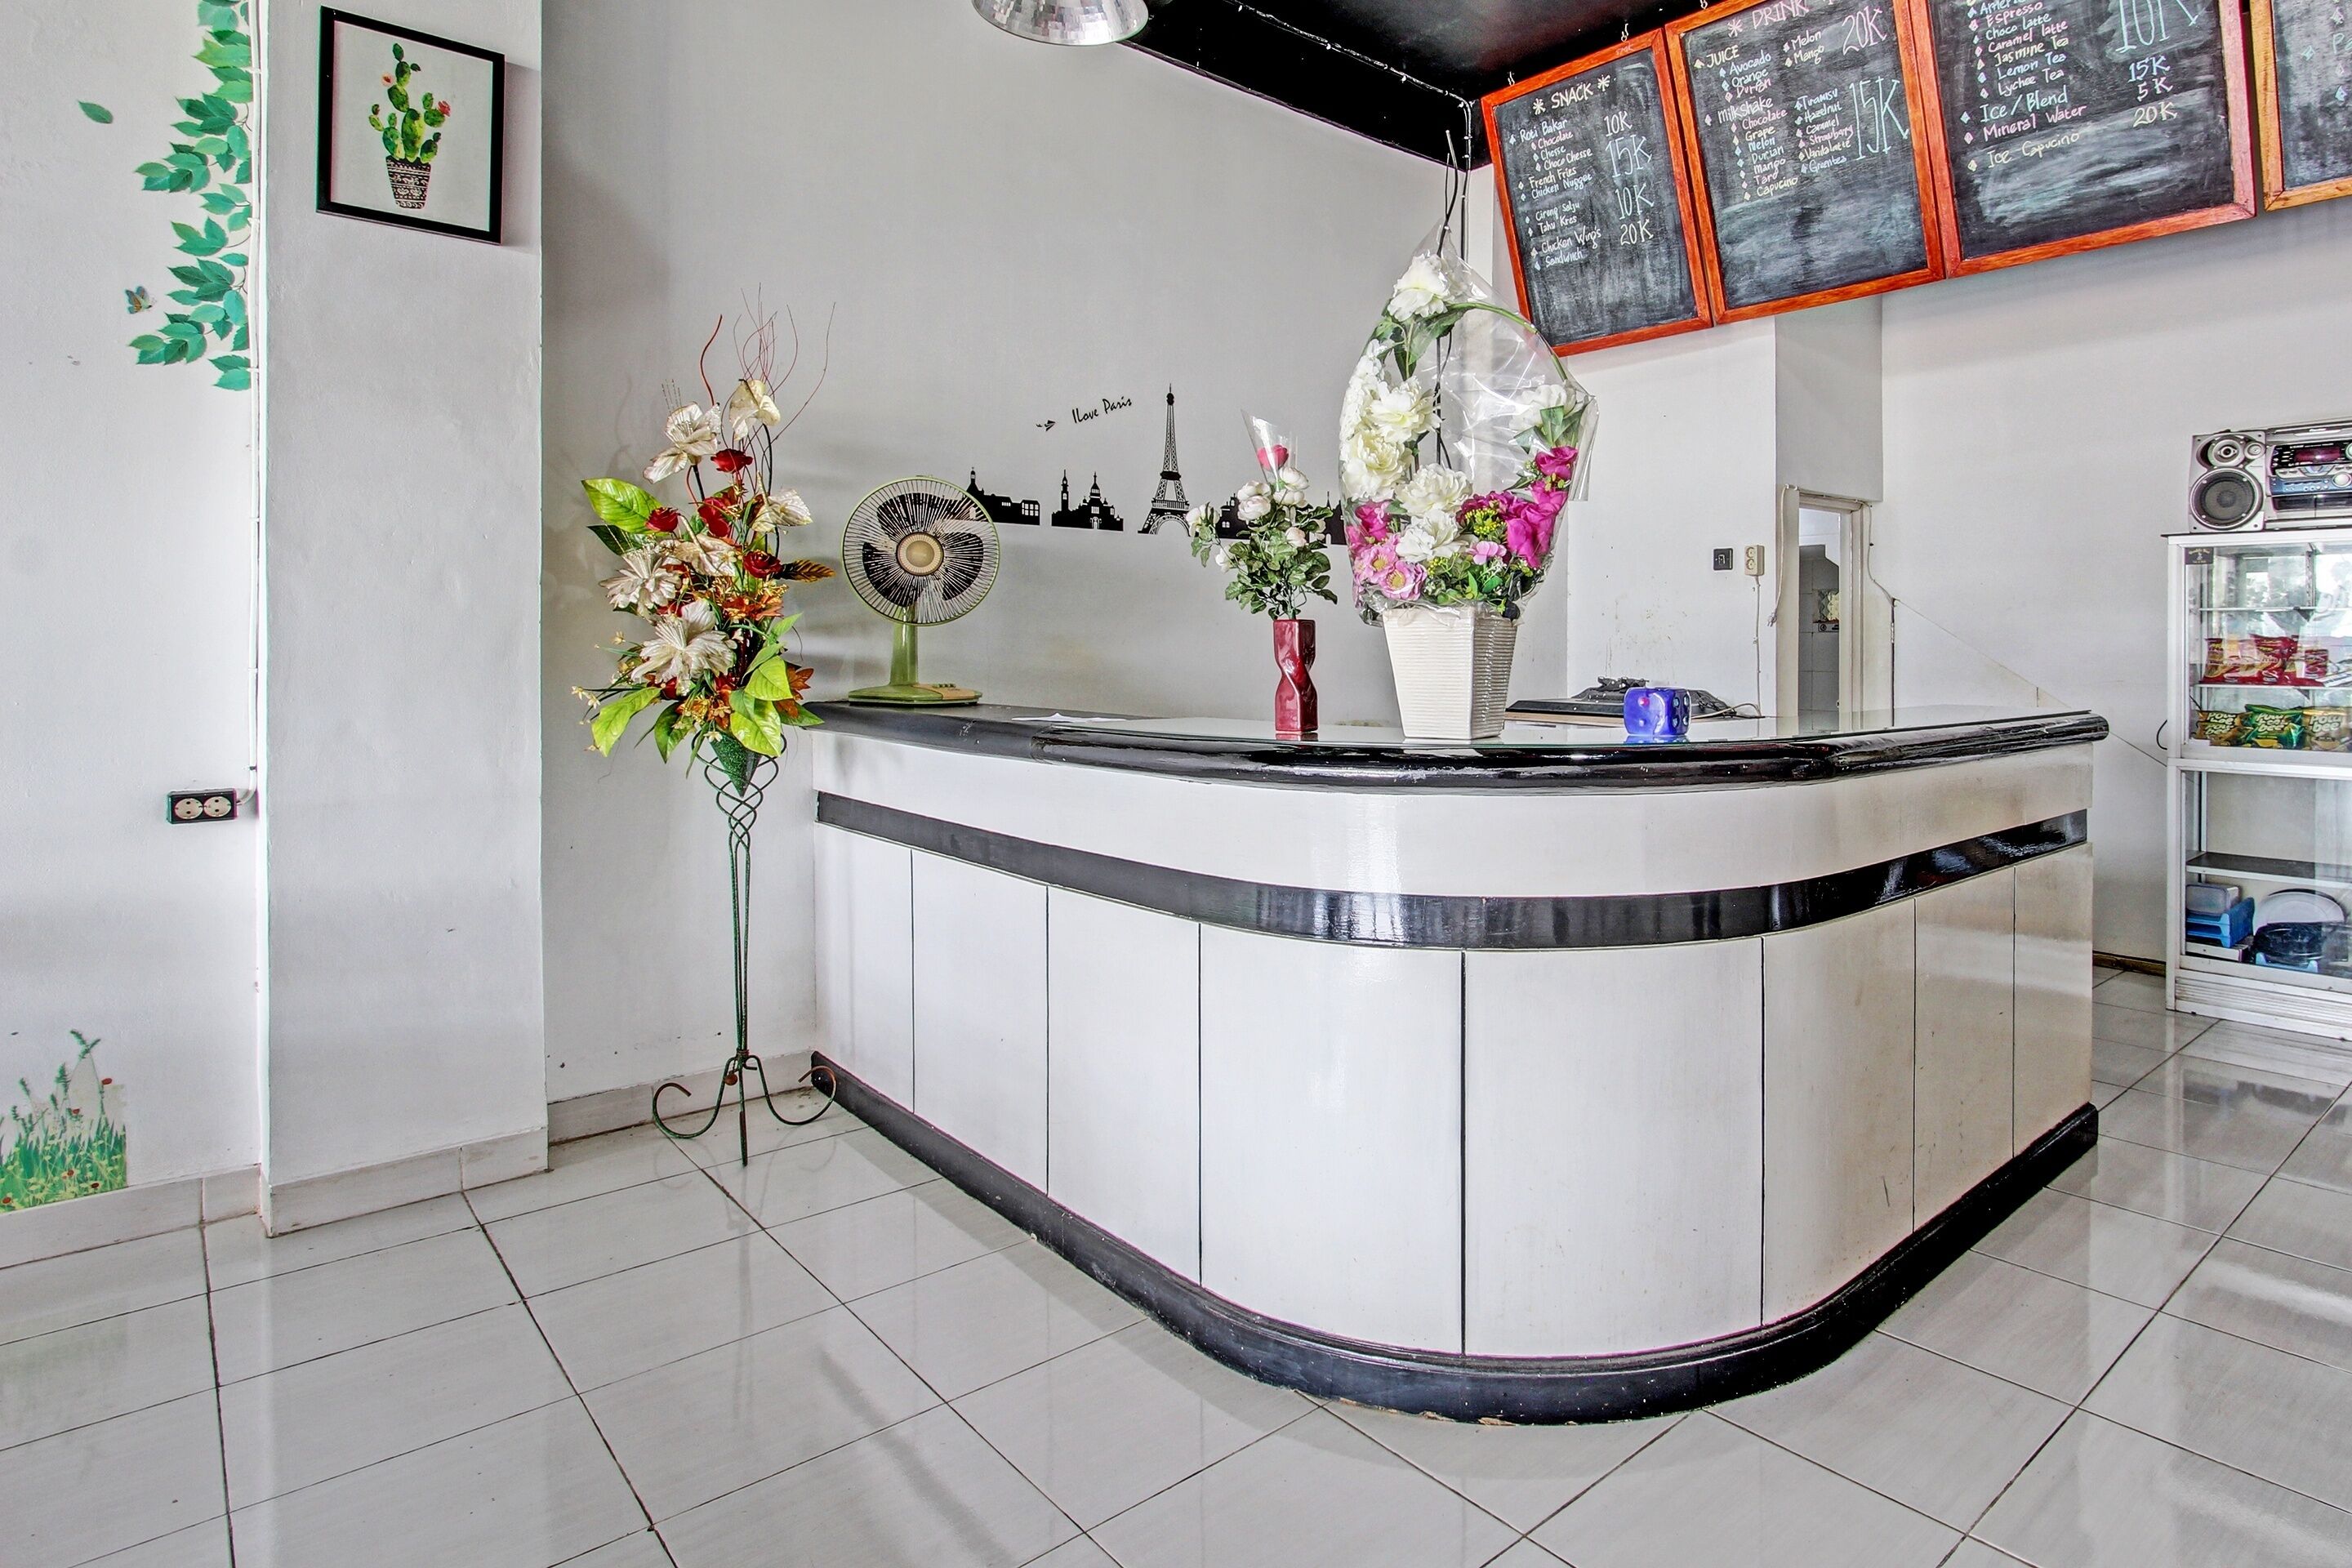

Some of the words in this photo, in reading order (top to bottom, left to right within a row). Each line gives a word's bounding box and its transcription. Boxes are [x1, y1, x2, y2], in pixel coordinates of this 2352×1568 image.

[1985, 2, 2042, 27] Espresso
[1791, 30, 1822, 51] Melon
[1842, 6, 1887, 56] 20K
[1989, 29, 2033, 53] Caramel
[1706, 45, 1740, 68] JUICE
[1730, 49, 1771, 75] Avocado
[1793, 45, 1824, 65] Mango
[1994, 42, 2045, 67] Jasmine
[2051, 35, 2069, 50] Tea
[1998, 60, 2038, 80] Lemon
[2045, 51, 2067, 66] Tea
[2128, 56, 2171, 82] 15K
[1731, 69, 1769, 88] Orange
[1998, 76, 2037, 97] Lychee
[2042, 68, 2065, 83] Tea
[1552, 82, 1593, 109] SNACK
[1742, 109, 1788, 130] Chocolate
[1804, 100, 1842, 122] Hazelnut
[1849, 76, 1909, 160] 15K
[1983, 113, 2037, 141] Mineral
[2045, 105, 2087, 123] Water
[2133, 101, 2177, 127] 20K
[1520, 126, 1539, 142] Roti
[1542, 118, 1567, 136] Bakar
[1604, 111, 1633, 137] 10K
[1745, 126, 1776, 141] Grape
[1538, 131, 1573, 149] Chocolate
[1748, 136, 1775, 152] Melon
[1987, 149, 2012, 168] Ice
[2022, 132, 2080, 158] Capucino
[1544, 158, 1565, 170] Choco
[1606, 135, 1652, 178] 15K
[1752, 145, 1784, 164] Durian
[1528, 171, 1556, 189] French
[1557, 167, 1577, 180] Fries
[1531, 184, 1559, 198] Chicken
[1563, 173, 1592, 190] Nugget
[1757, 176, 1798, 196] Capucino
[1615, 182, 1655, 220] 10K
[1537, 220, 1556, 234] Tahu
[1560, 215, 1577, 226] Kres
[1620, 219, 1654, 246] 20K
[1542, 236, 1572, 253] Chicken
[1545, 247, 1584, 268] Sandwich
[1102, 396, 1132, 414] Paris
